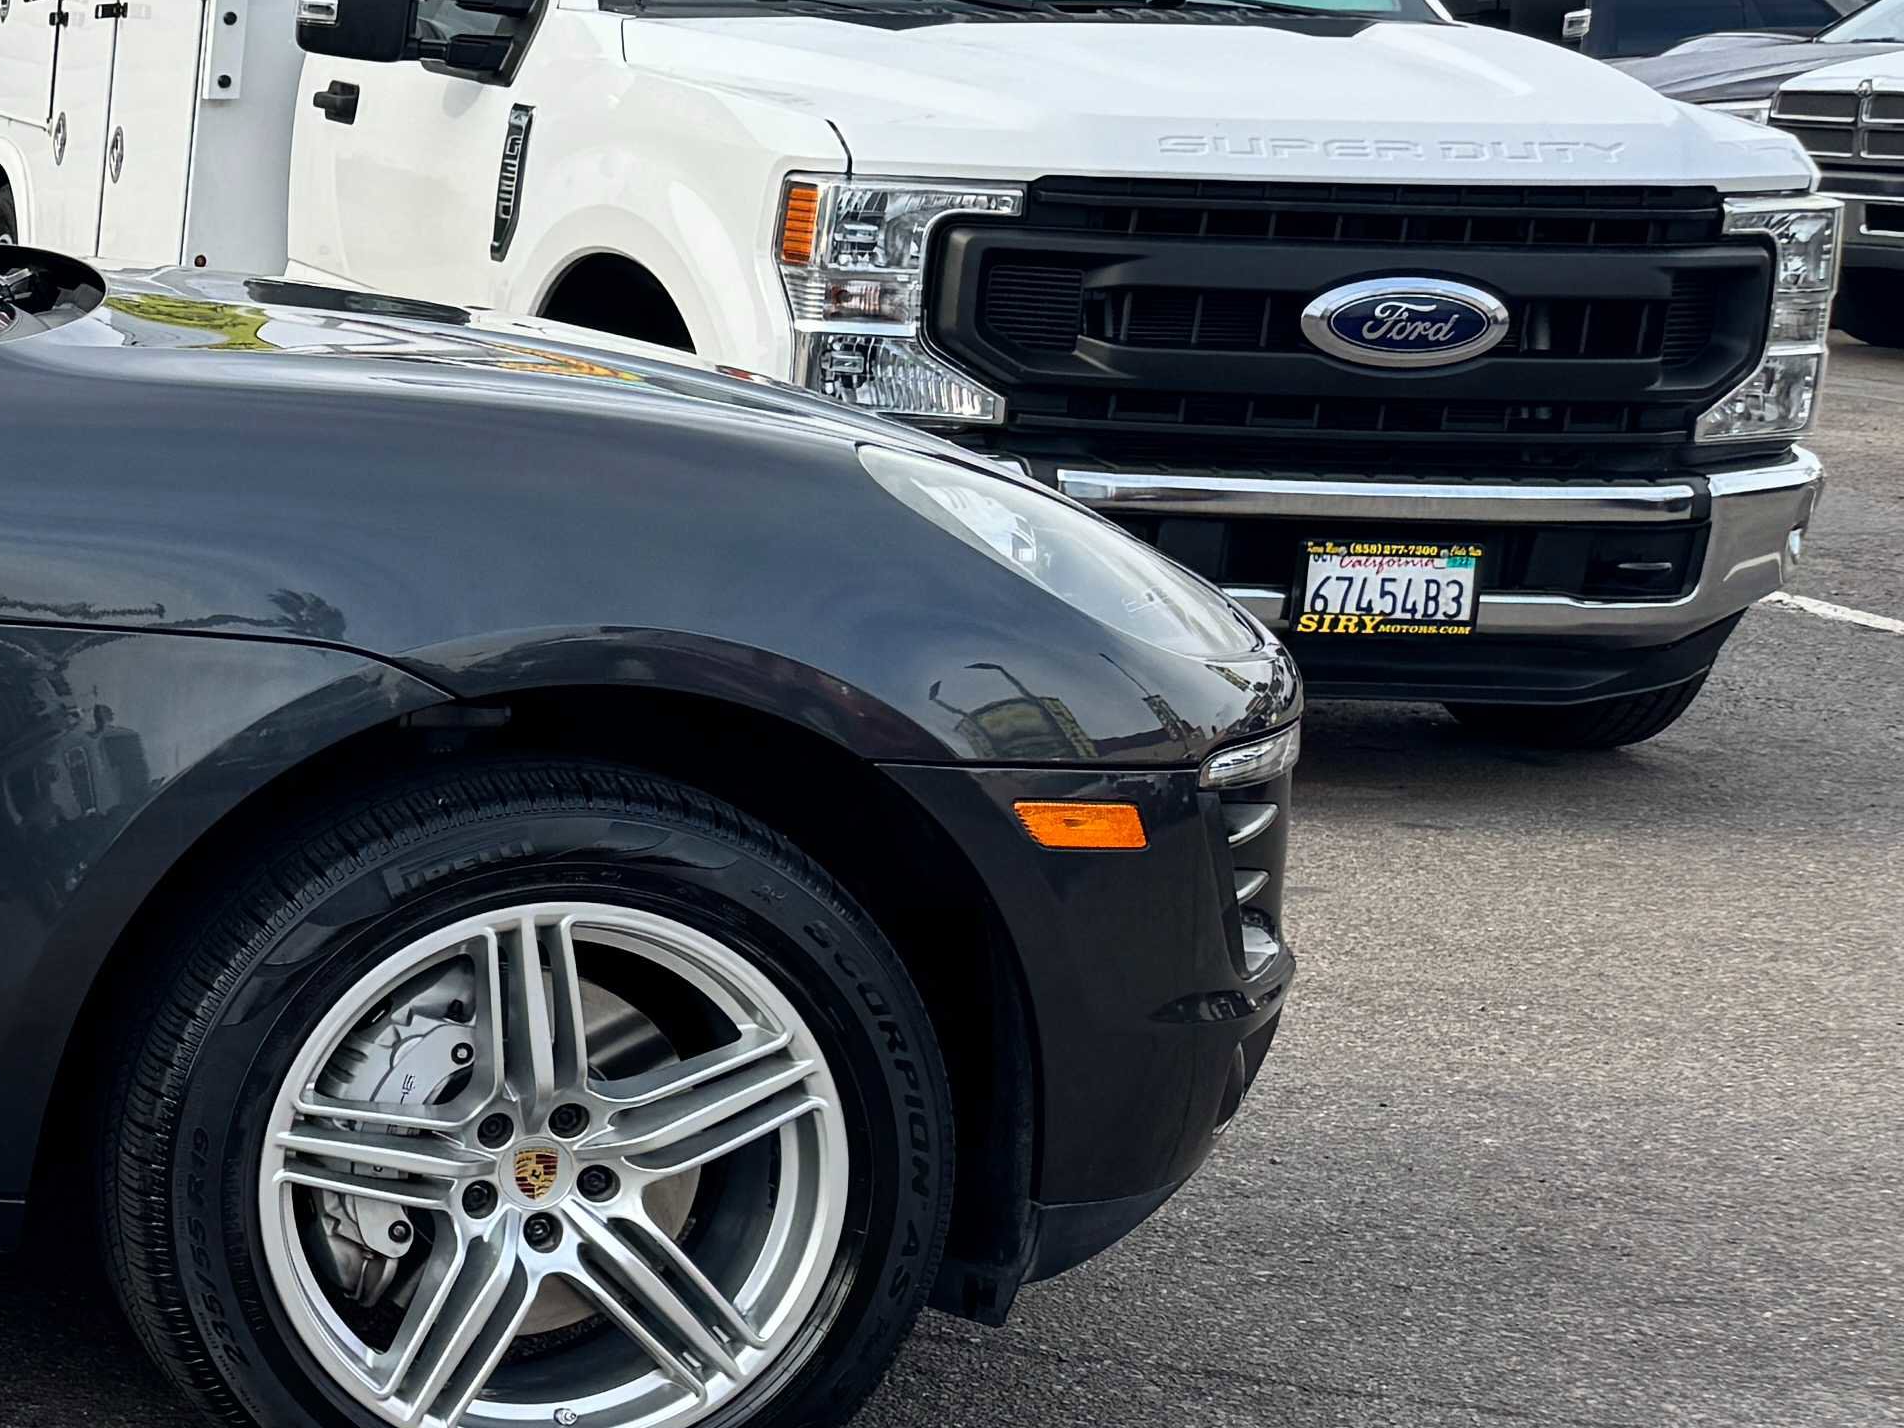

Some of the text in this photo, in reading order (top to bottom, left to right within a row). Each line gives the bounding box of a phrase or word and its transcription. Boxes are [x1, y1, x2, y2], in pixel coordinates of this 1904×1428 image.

[1158, 135, 1625, 164] SUPER DUTY
[1362, 301, 1460, 342] Ford
[1310, 575, 1464, 619] 67454B3
[1297, 614, 1384, 634] SIRY
[804, 918, 930, 1199] SCORPION
[188, 1216, 250, 1367] 235/55
